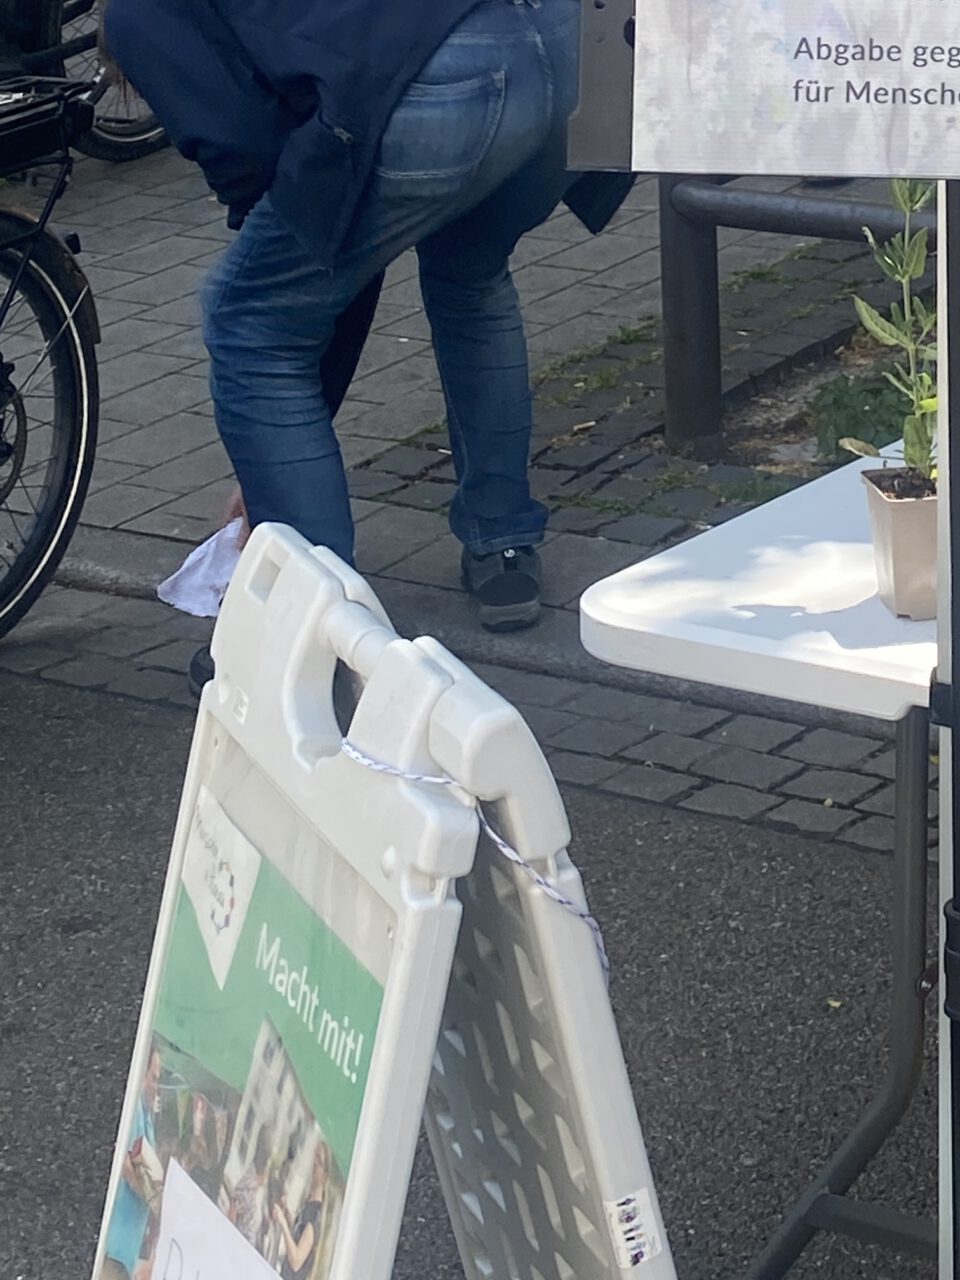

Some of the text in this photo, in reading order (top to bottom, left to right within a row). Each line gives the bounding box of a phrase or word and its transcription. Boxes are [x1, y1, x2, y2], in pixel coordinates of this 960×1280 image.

[793, 37, 902, 68] Abgabe
[793, 79, 835, 104] für
[256, 922, 364, 1085] Macht mit!
